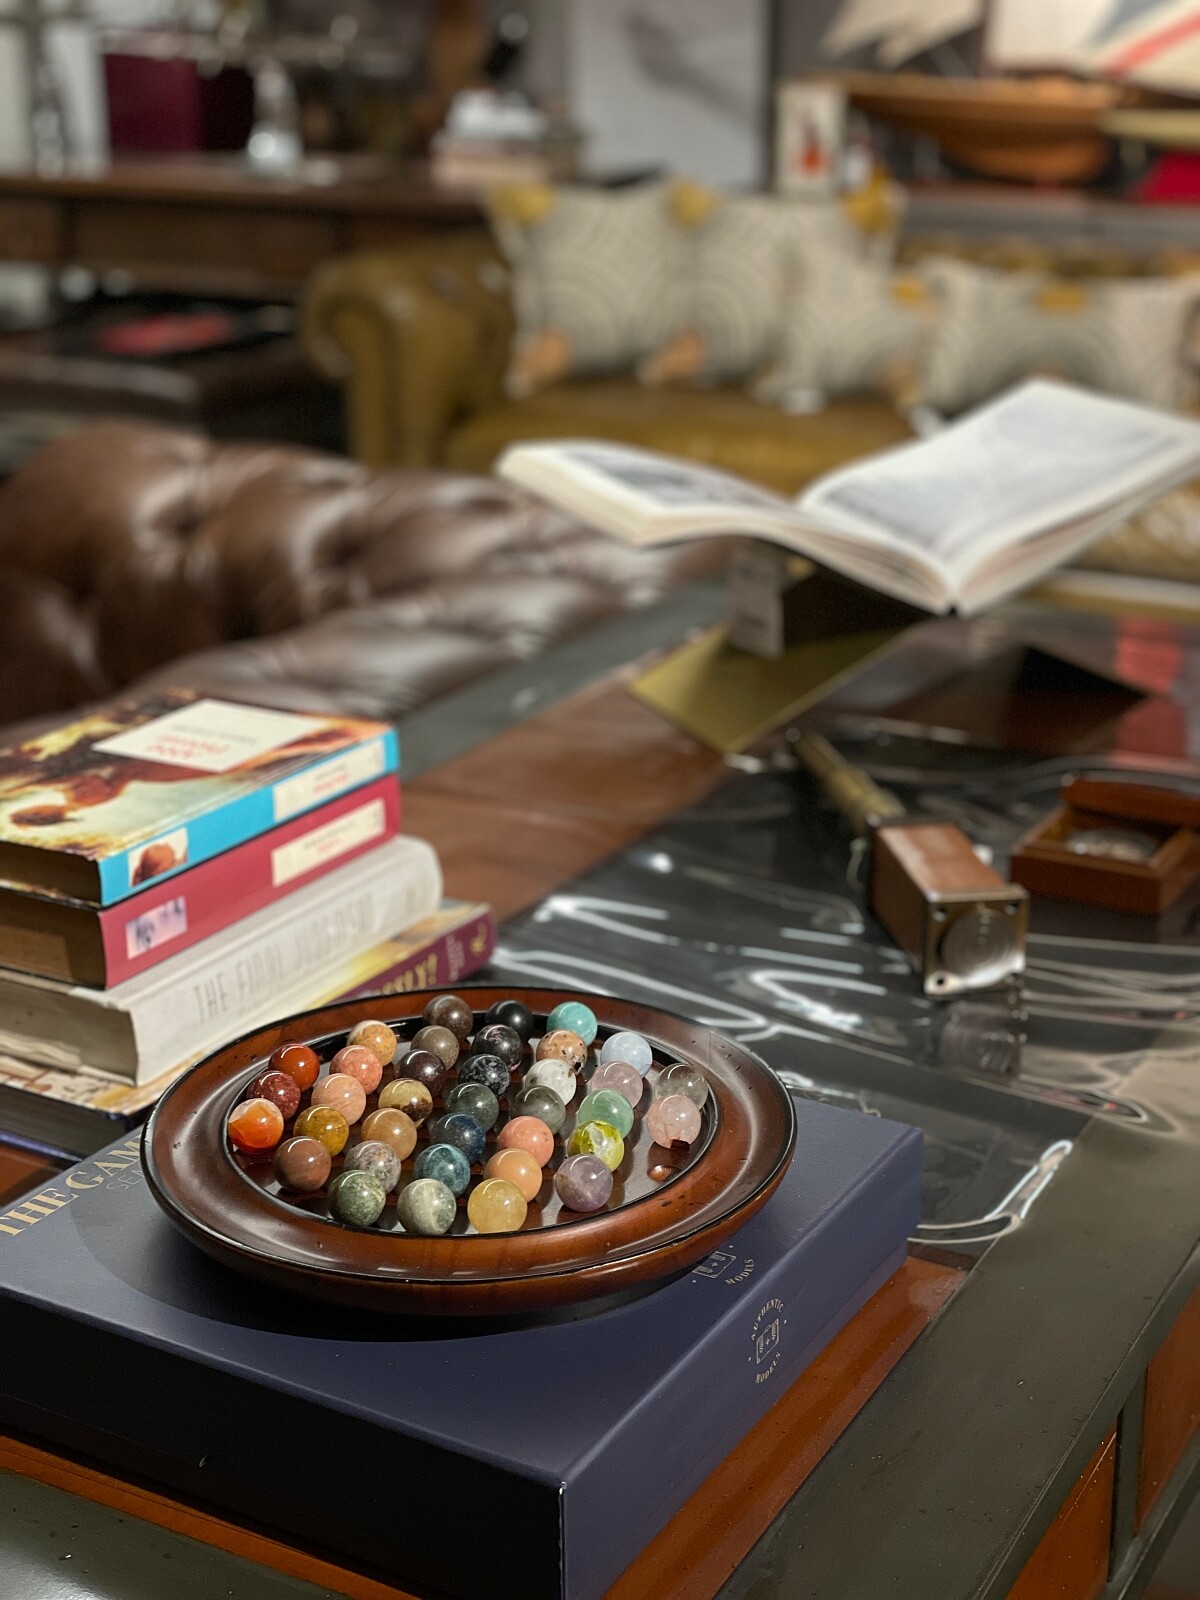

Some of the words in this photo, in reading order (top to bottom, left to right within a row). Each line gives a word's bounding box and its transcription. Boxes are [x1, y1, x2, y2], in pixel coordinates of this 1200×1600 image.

[192, 971, 228, 1025] THE
[0, 1187, 79, 1236] THE
[724, 1259, 755, 1285] MODELS
[751, 1298, 784, 1341] AUTHENTIC
[755, 1351, 781, 1384] MODELS
